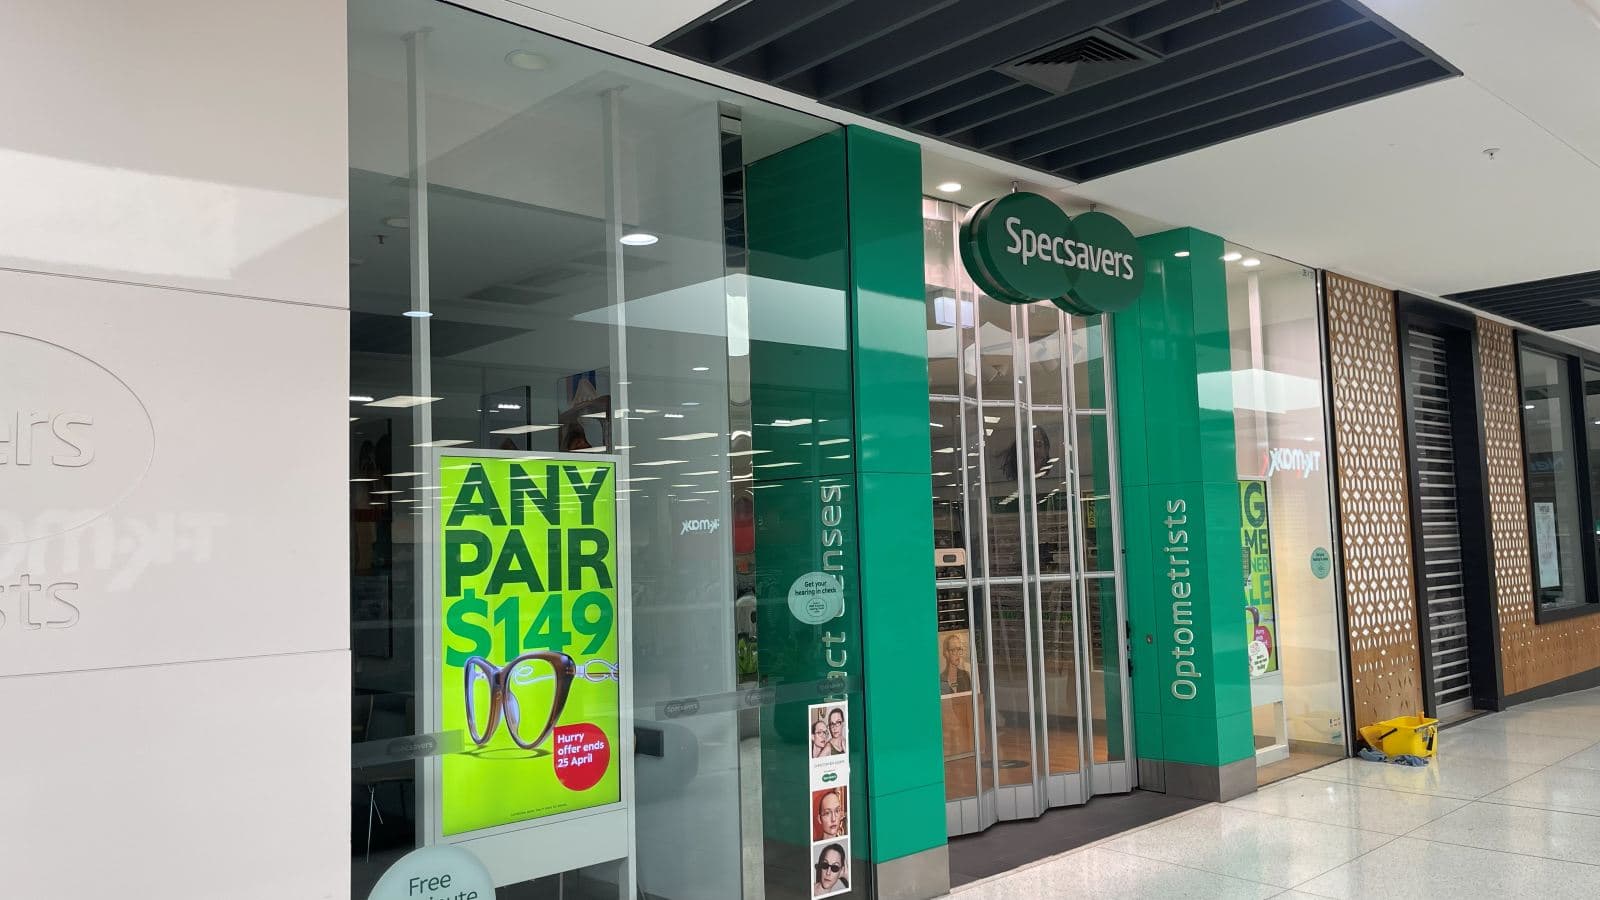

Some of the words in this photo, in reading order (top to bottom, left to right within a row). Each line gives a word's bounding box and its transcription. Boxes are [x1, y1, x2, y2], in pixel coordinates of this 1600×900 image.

[1005, 216, 1134, 281] Specsavers
[446, 463, 609, 527] ANY
[446, 528, 613, 597] PAIR
[794, 588, 816, 597] hearing
[1163, 499, 1201, 700] Optometrists
[446, 588, 614, 667] $149
[557, 732, 585, 744] Hurry
[557, 744, 582, 756] offer
[582, 740, 605, 752] ends
[557, 758, 569, 768] 25
[570, 753, 593, 767] April
[408, 873, 452, 897] Free
